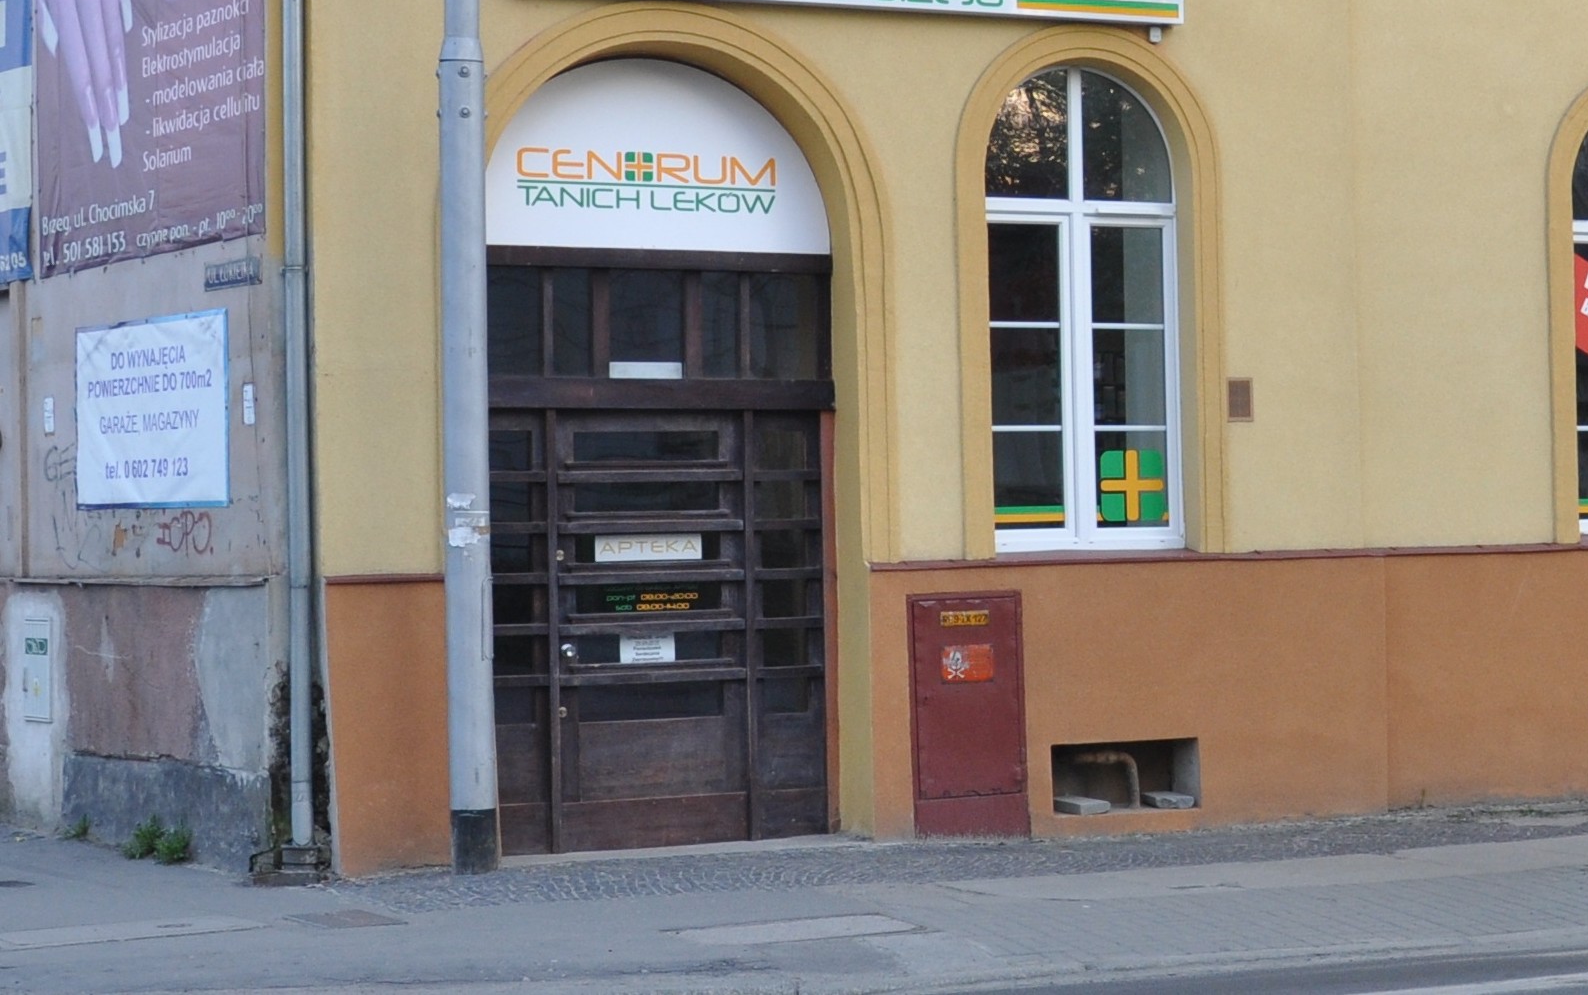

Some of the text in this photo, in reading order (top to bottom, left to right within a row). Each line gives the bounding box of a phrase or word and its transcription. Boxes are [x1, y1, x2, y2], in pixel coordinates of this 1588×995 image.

[142, 13, 193, 47] Stylizacja
[142, 30, 241, 78] Elektrostymulacja
[152, 56, 265, 107] modelowania ciała
[152, 104, 210, 138] likwidacja
[143, 145, 192, 173] Solarium
[42, 190, 155, 238] Brzeg, ul. Chocimska 7
[517, 185, 776, 214] TANICH LEKÓW
[63, 240, 81, 261] 501
[85, 236, 103, 258] 581
[106, 230, 127, 253] 153
[111, 344, 186, 372] DO WYNAJĘCIA
[88, 369, 212, 399] POWIERZCHNIE DO 700m2
[100, 409, 200, 436] GARAŻE, MAGAZYNY
[105, 457, 189, 479] tel. 0 602 749 123
[600, 539, 698, 555] APTEKA
